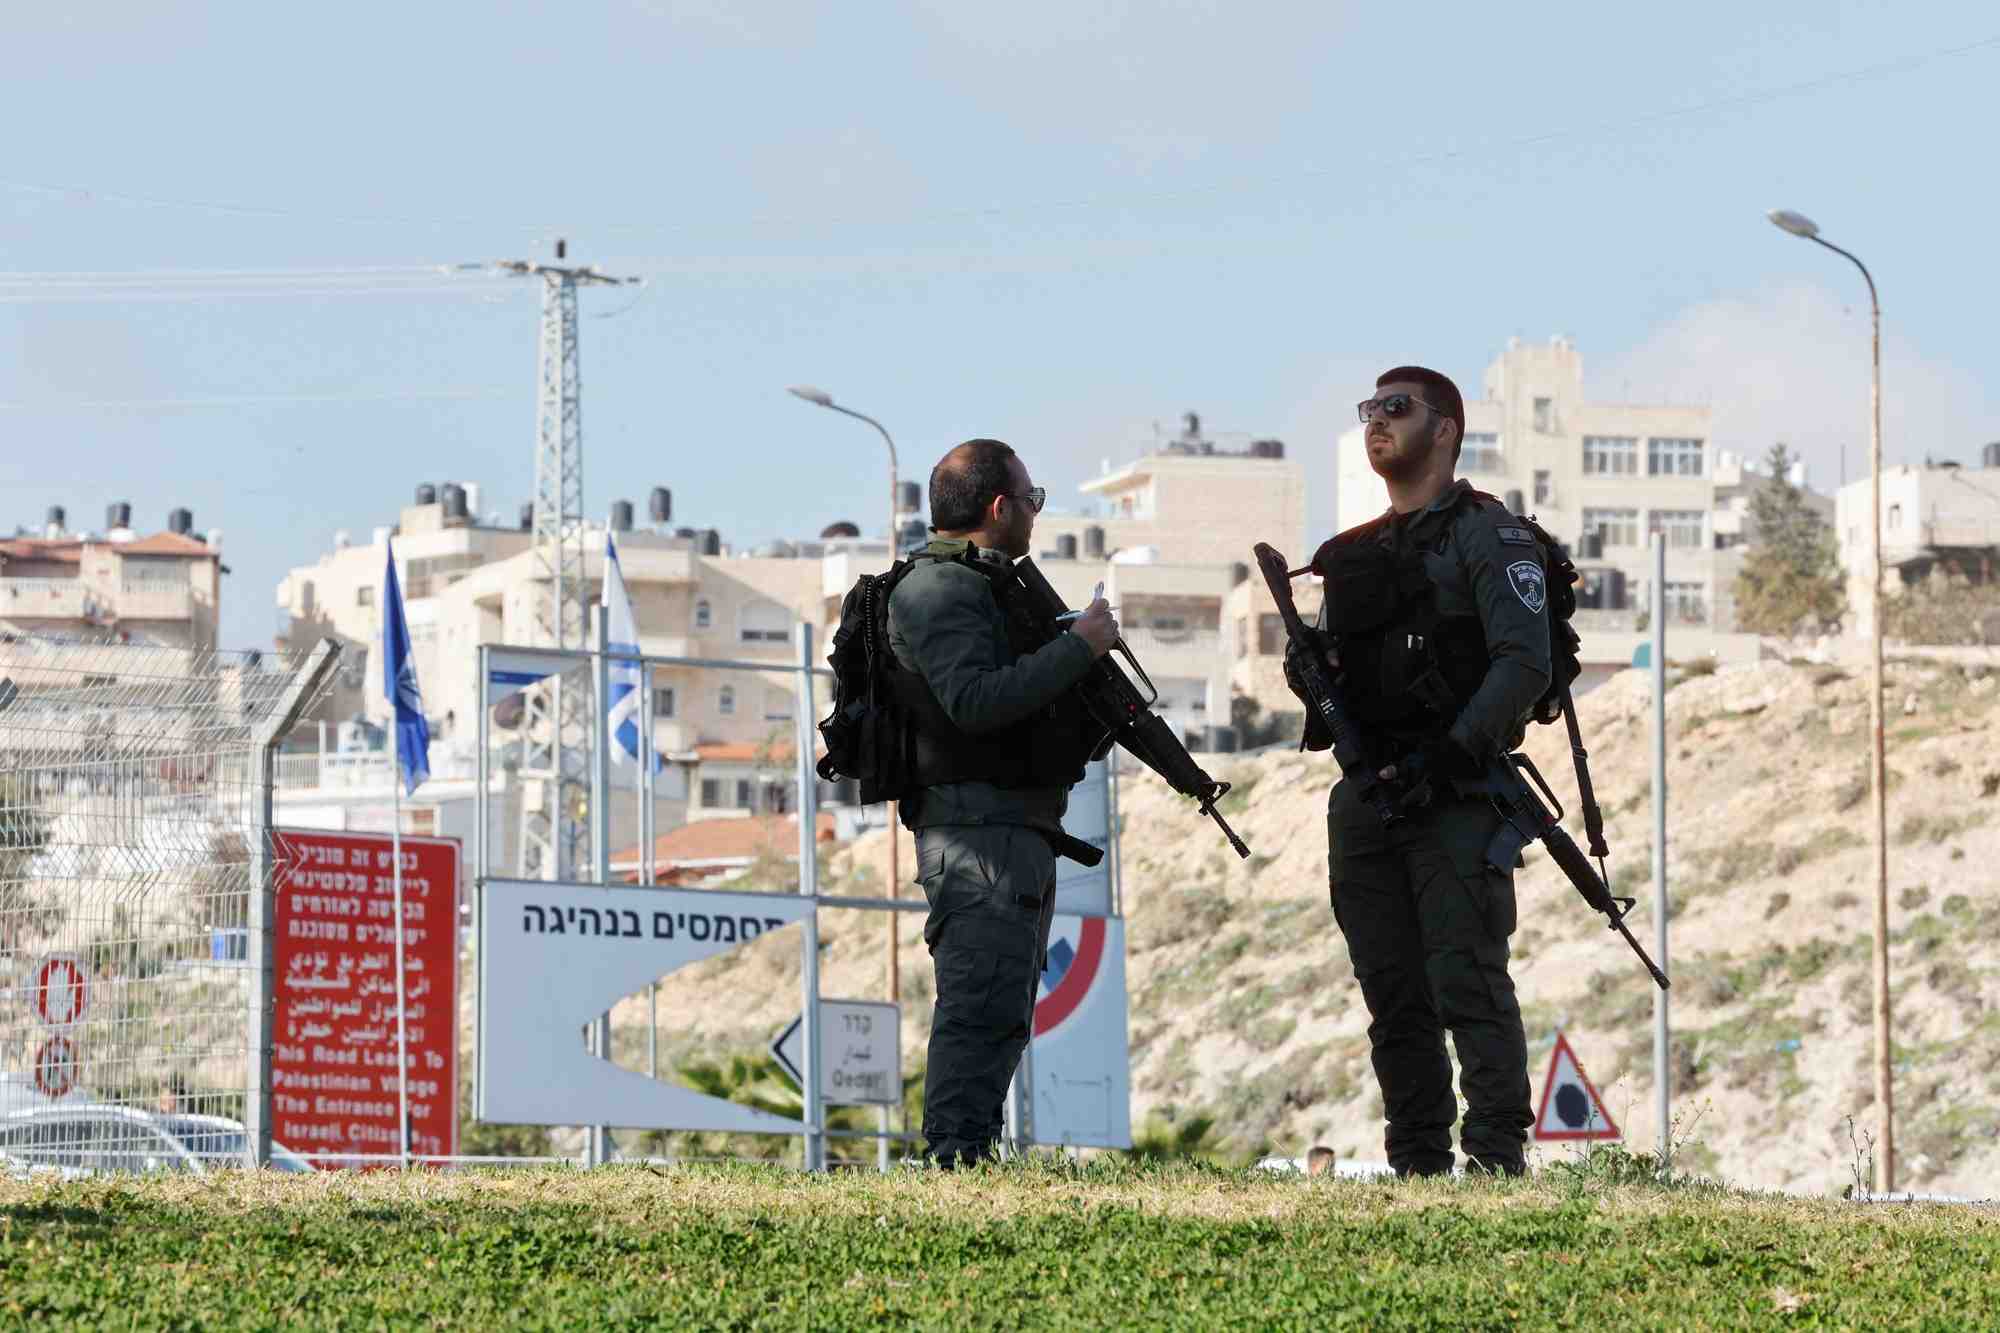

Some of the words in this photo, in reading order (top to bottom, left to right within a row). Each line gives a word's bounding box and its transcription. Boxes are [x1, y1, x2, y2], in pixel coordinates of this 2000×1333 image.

[298, 844, 345, 865] מוביל
[351, 849, 370, 867] זה
[377, 850, 418, 870] כבש
[291, 894, 361, 917] לאזרחים
[367, 900, 425, 921] הכיסה
[288, 918, 349, 942] מסוכנת
[523, 904, 643, 938] בנהיגה
[355, 922, 428, 946] ישאלים
[312, 1045, 358, 1065] Road
[423, 1050, 445, 1071] To
[272, 1068, 372, 1092] Palestinian
[274, 1093, 309, 1114] The
[314, 1095, 395, 1118] Entrance
[347, 1122, 421, 1144] Citizes
